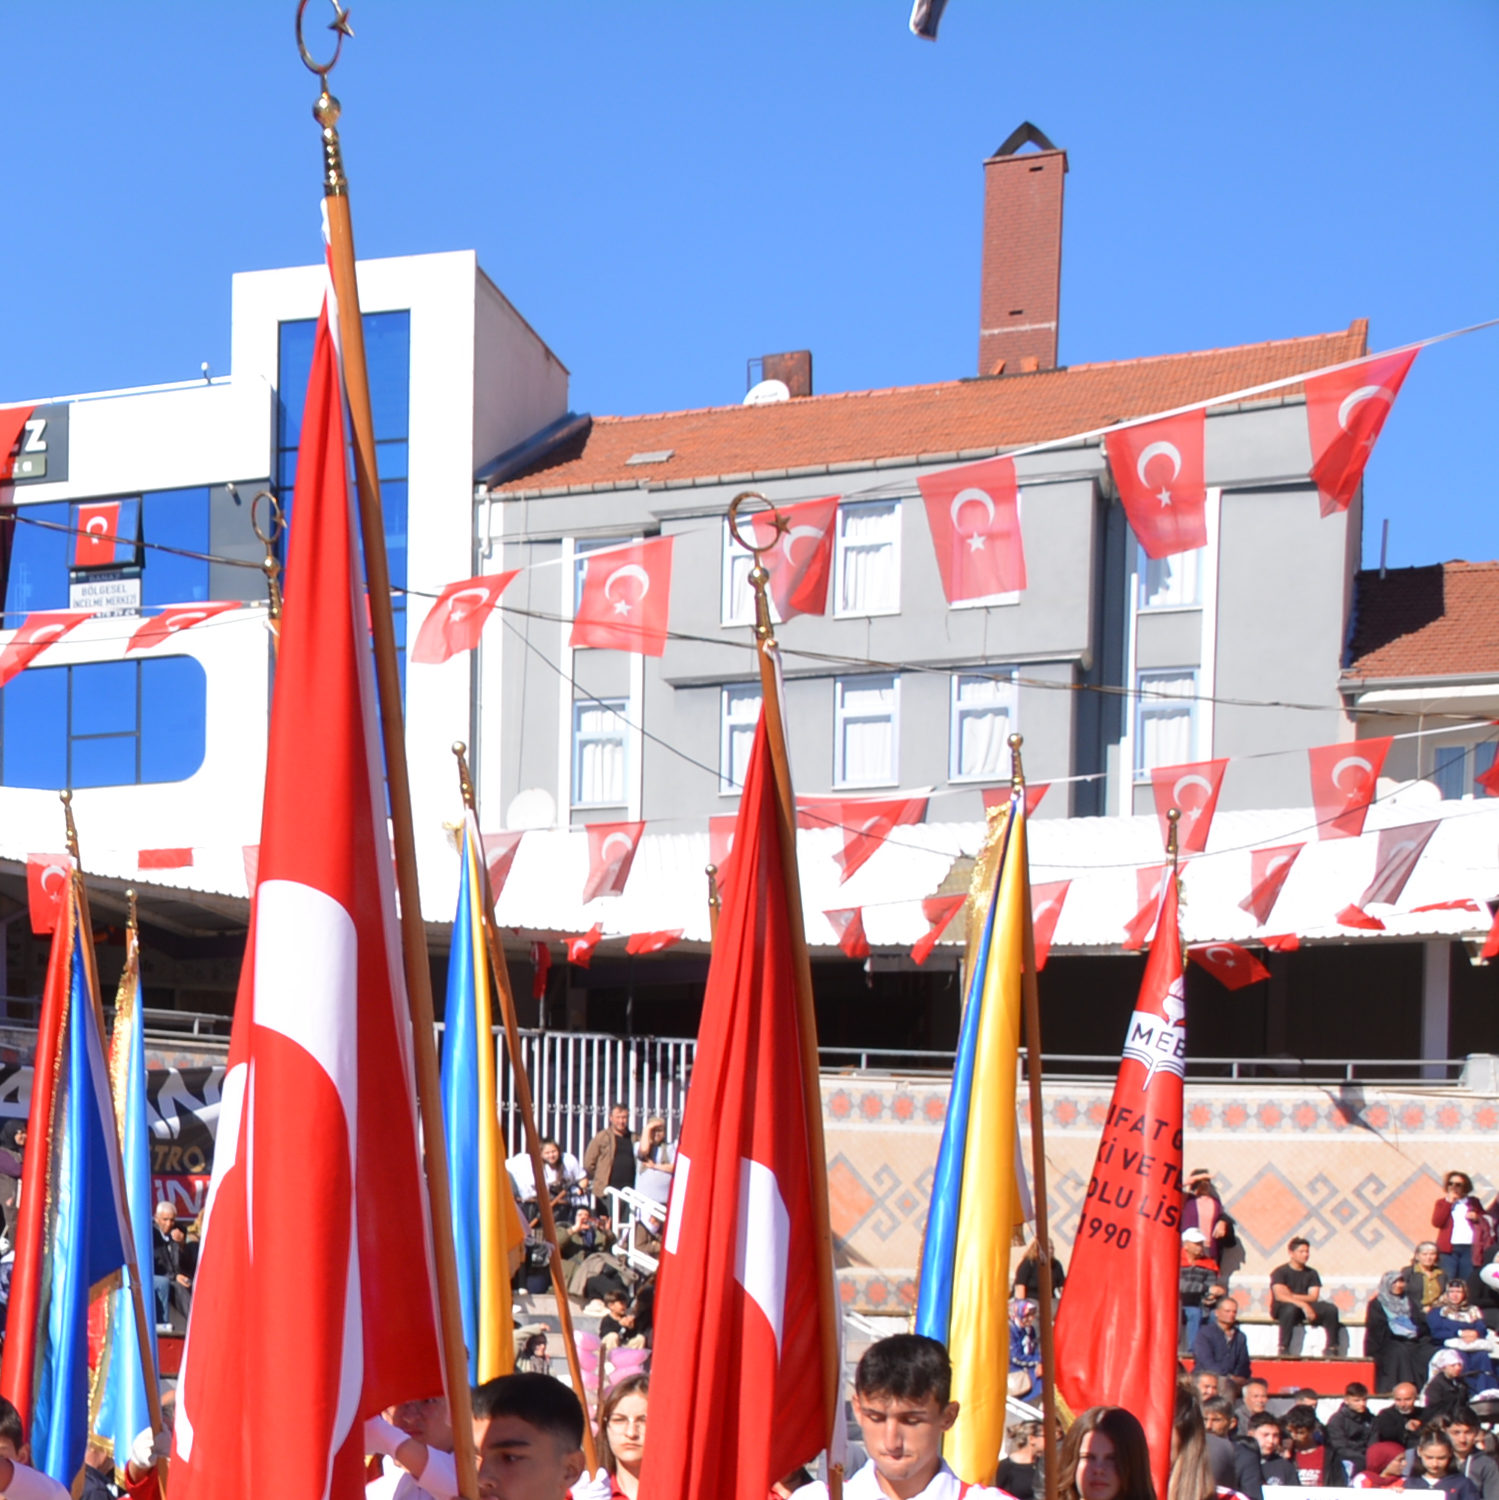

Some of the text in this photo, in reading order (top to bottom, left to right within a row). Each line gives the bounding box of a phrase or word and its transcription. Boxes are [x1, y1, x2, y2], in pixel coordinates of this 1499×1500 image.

[81, 584, 127, 596] BÖLGESEL
[1131, 1022, 1185, 1059] MEB
[1122, 1147, 1156, 1177] VE
[1077, 1213, 1132, 1249] 1990
